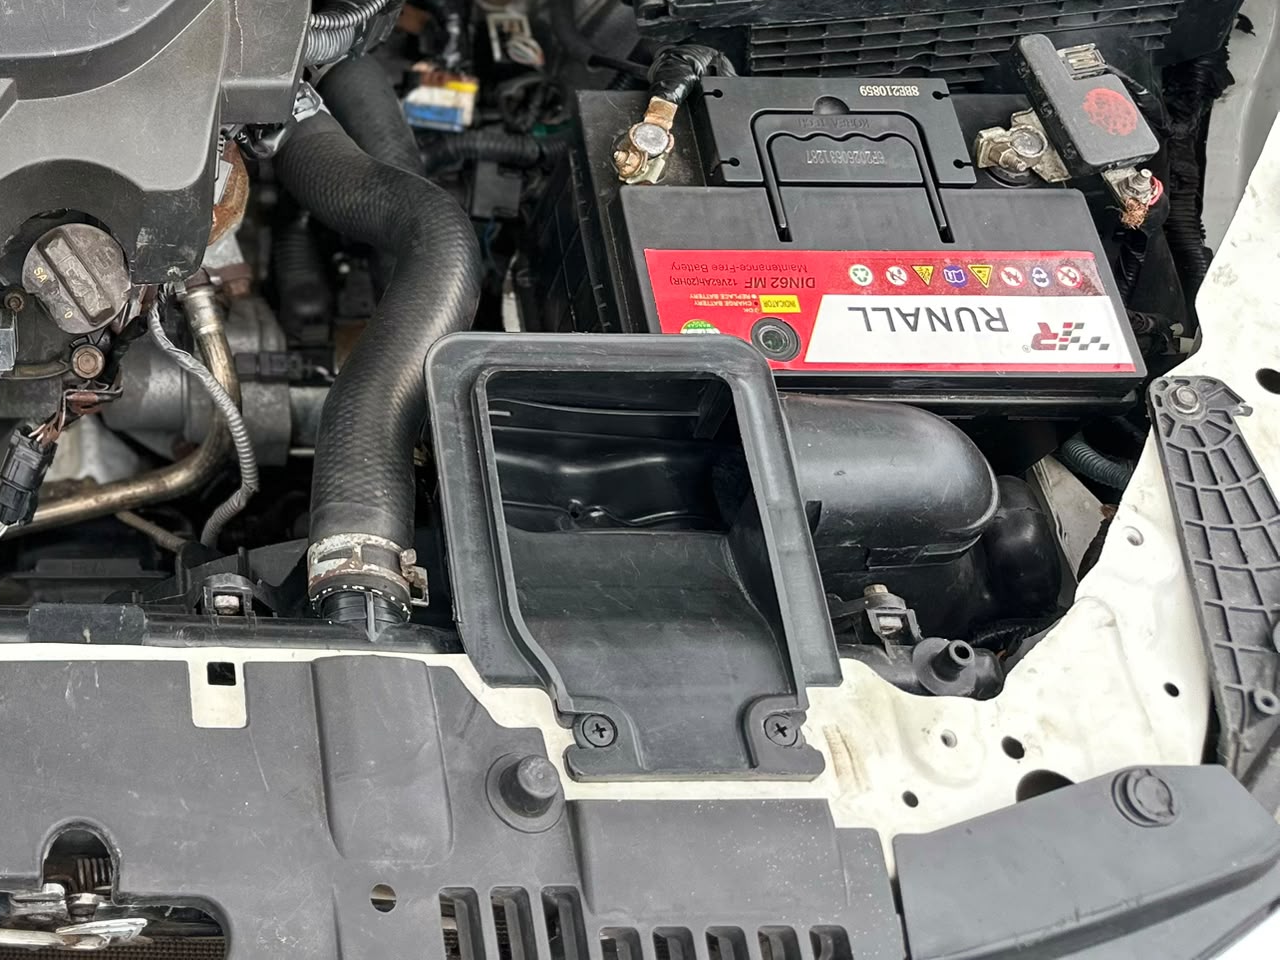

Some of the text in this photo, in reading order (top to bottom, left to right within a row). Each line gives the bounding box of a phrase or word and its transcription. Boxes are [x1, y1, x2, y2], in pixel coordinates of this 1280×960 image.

[671, 261, 808, 273] Maintenance-Free Battery
[744, 276, 767, 289] MF
[770, 276, 816, 289] DIN62
[763, 299, 797, 308] INDICATOR
[848, 306, 1010, 333] RUNALL
